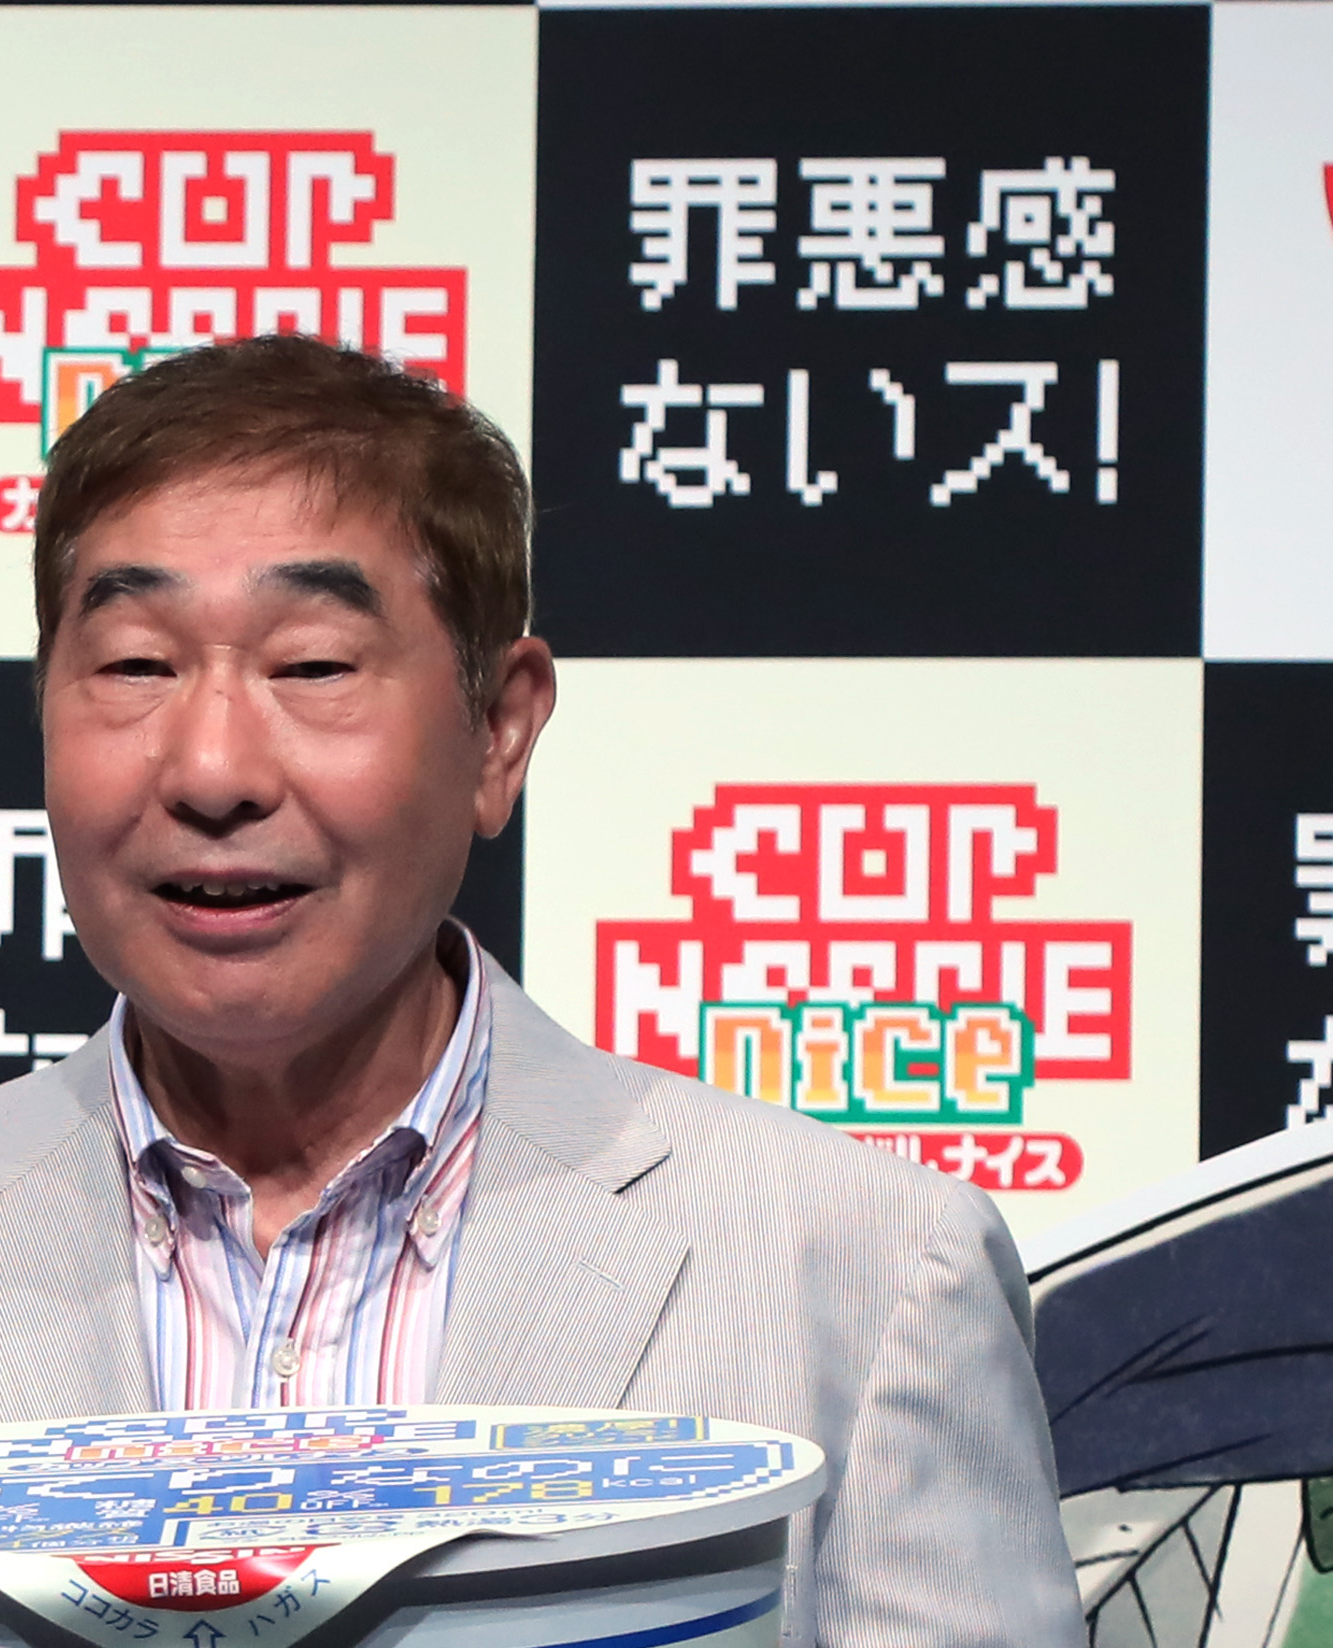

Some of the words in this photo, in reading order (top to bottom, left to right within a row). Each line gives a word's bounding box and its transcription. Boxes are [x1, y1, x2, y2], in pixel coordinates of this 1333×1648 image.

[36, 151, 378, 267] CUP
[626, 157, 1116, 310] 罪悪感
[619, 357, 1121, 508] ないス!
[691, 804, 1037, 922] CUP
[704, 1005, 1032, 1118] nice
[164, 1492, 294, 1516] 40
[413, 1479, 594, 1505] 178
[602, 1475, 698, 1489] kcal
[61, 1576, 159, 1641] ココカラ
[147, 1566, 242, 1600] 日清食品
[248, 1568, 332, 1637] ハガス
